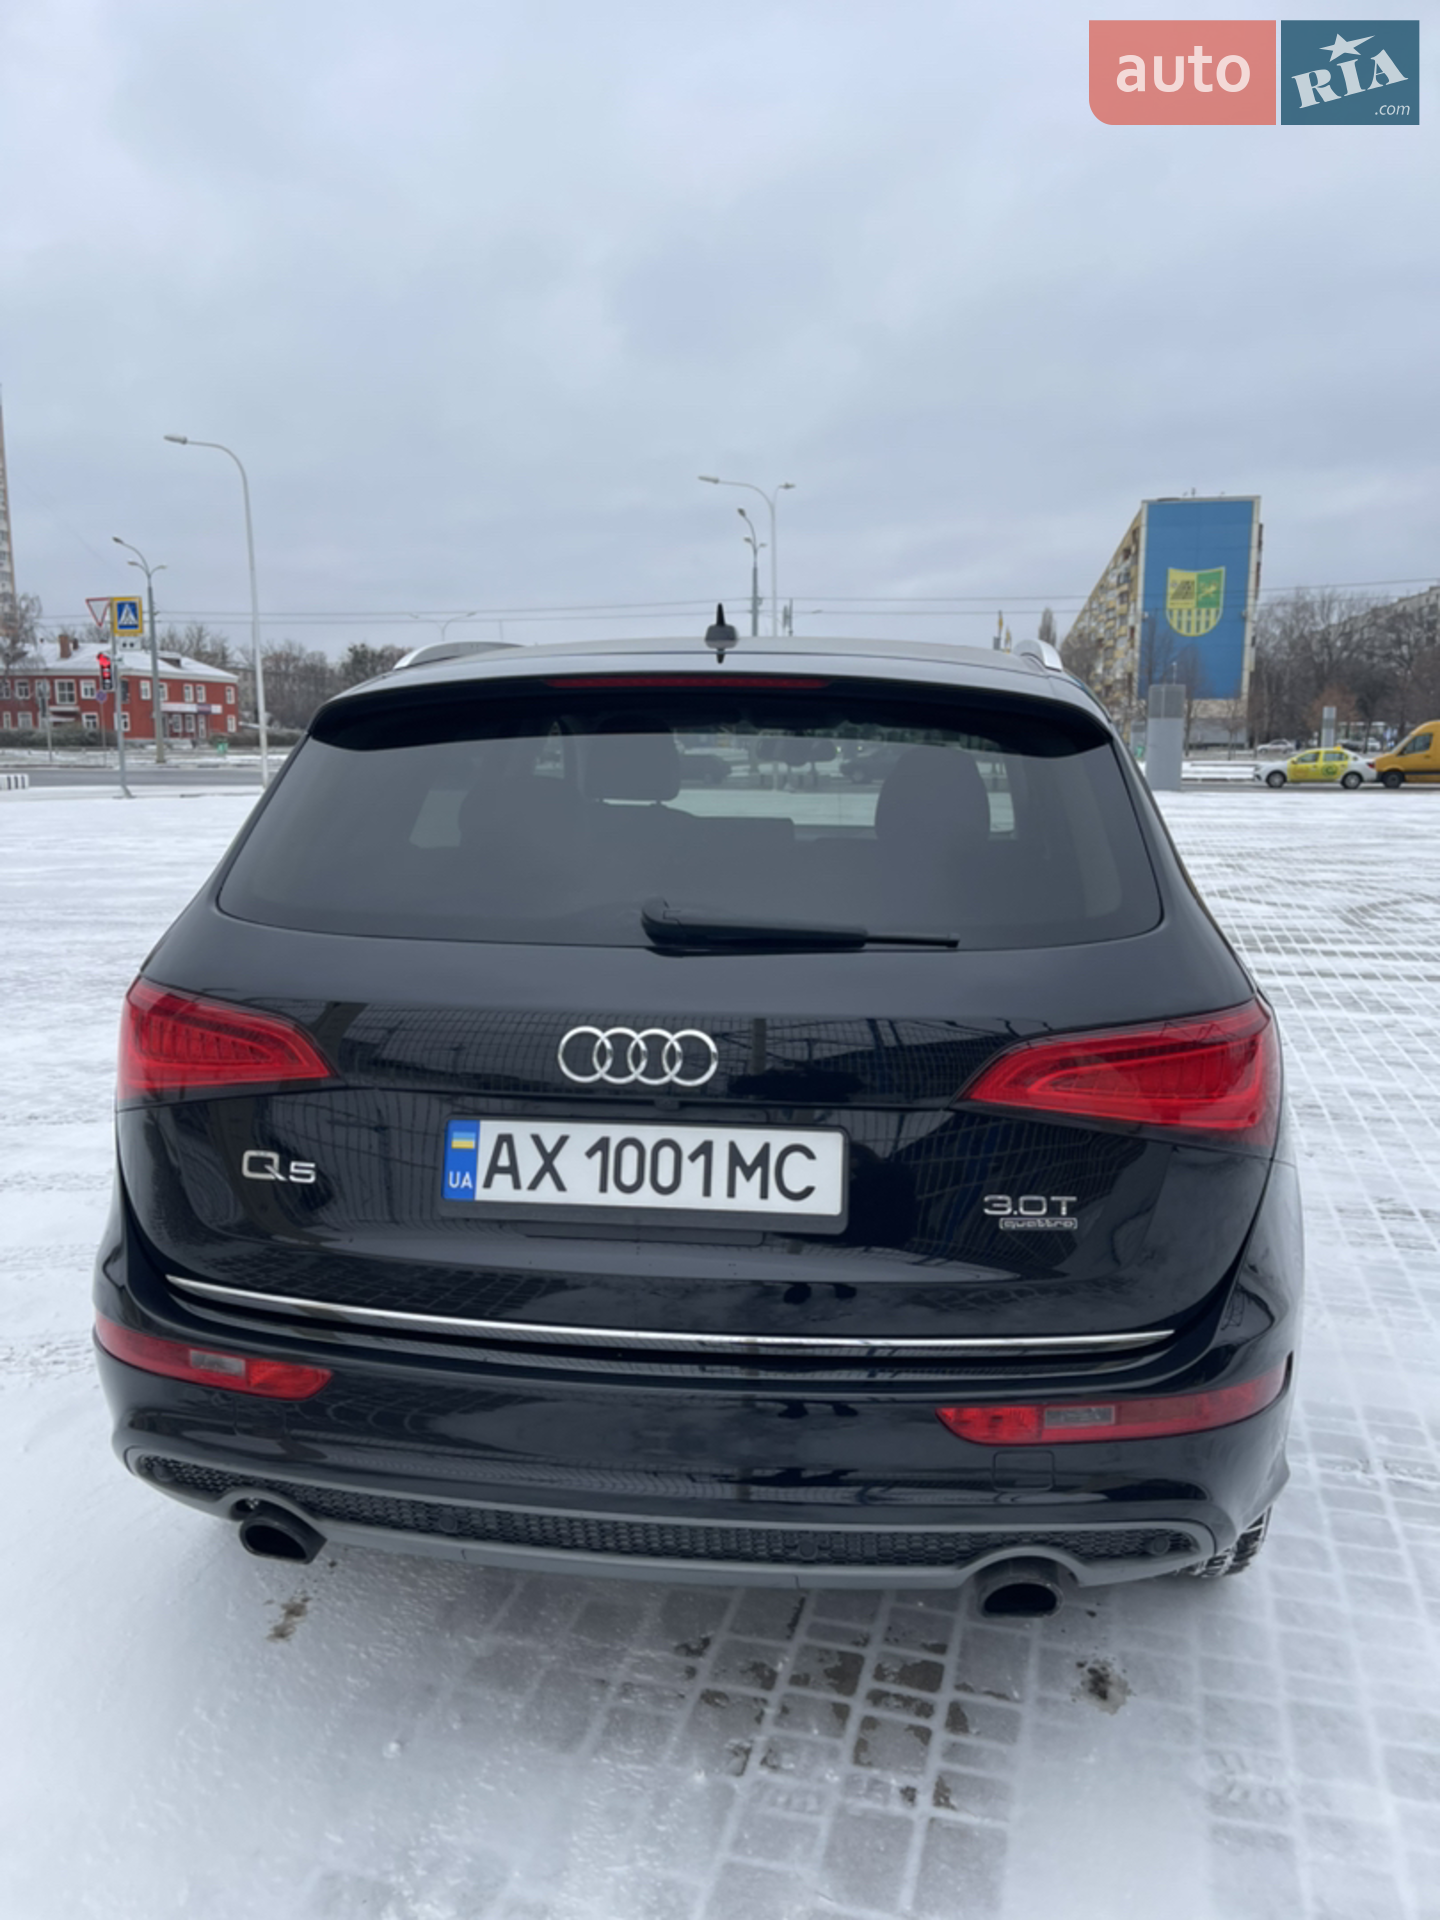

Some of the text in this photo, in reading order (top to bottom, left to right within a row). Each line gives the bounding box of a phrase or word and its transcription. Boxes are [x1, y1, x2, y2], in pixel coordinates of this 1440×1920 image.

[242, 1149, 317, 1184] Q5
[482, 1133, 817, 1202] AX 1001 MC
[448, 1170, 473, 1190] UA
[983, 1194, 1078, 1216] 3.0T
[1002, 1218, 1076, 1230] quattro
